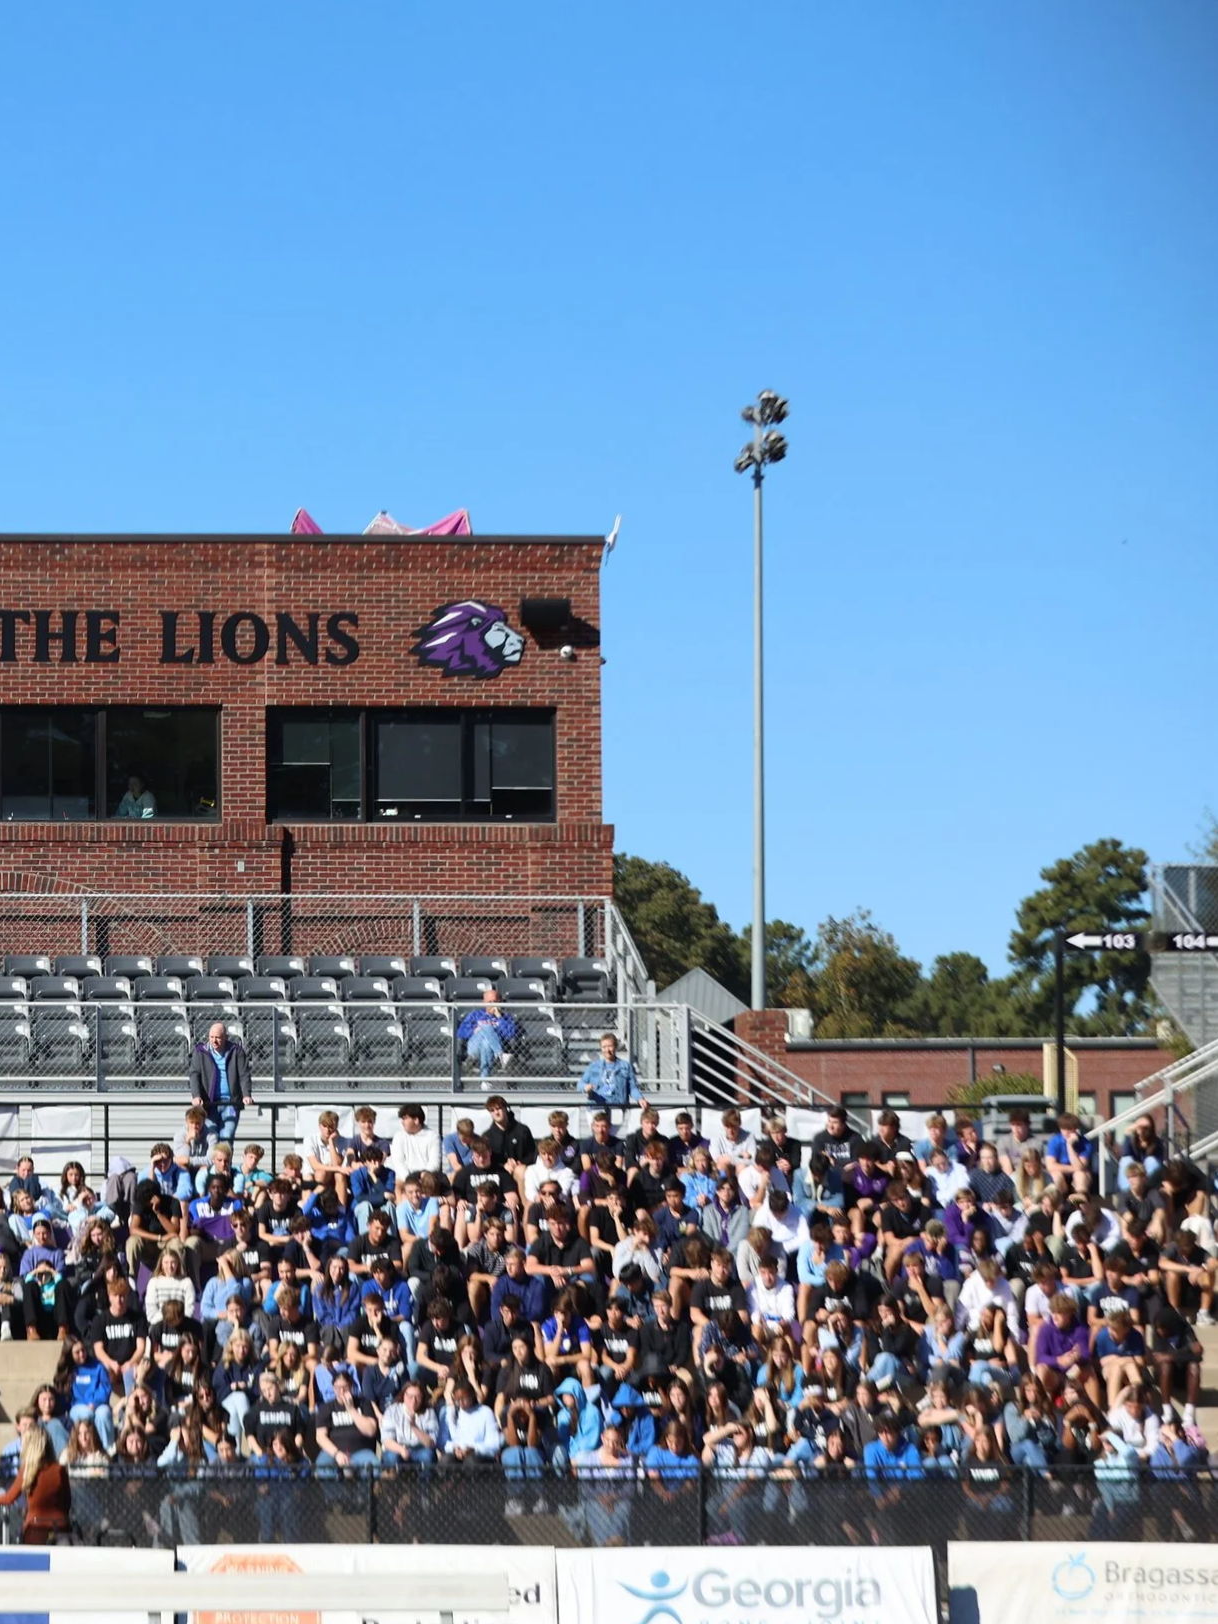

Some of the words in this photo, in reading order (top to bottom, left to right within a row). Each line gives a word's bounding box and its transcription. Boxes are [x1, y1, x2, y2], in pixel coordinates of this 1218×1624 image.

[158, 611, 361, 665] LIONS
[1102, 933, 1136, 949] 103
[1173, 933, 1206, 949] 104
[691, 1566, 882, 1619] Georgia
